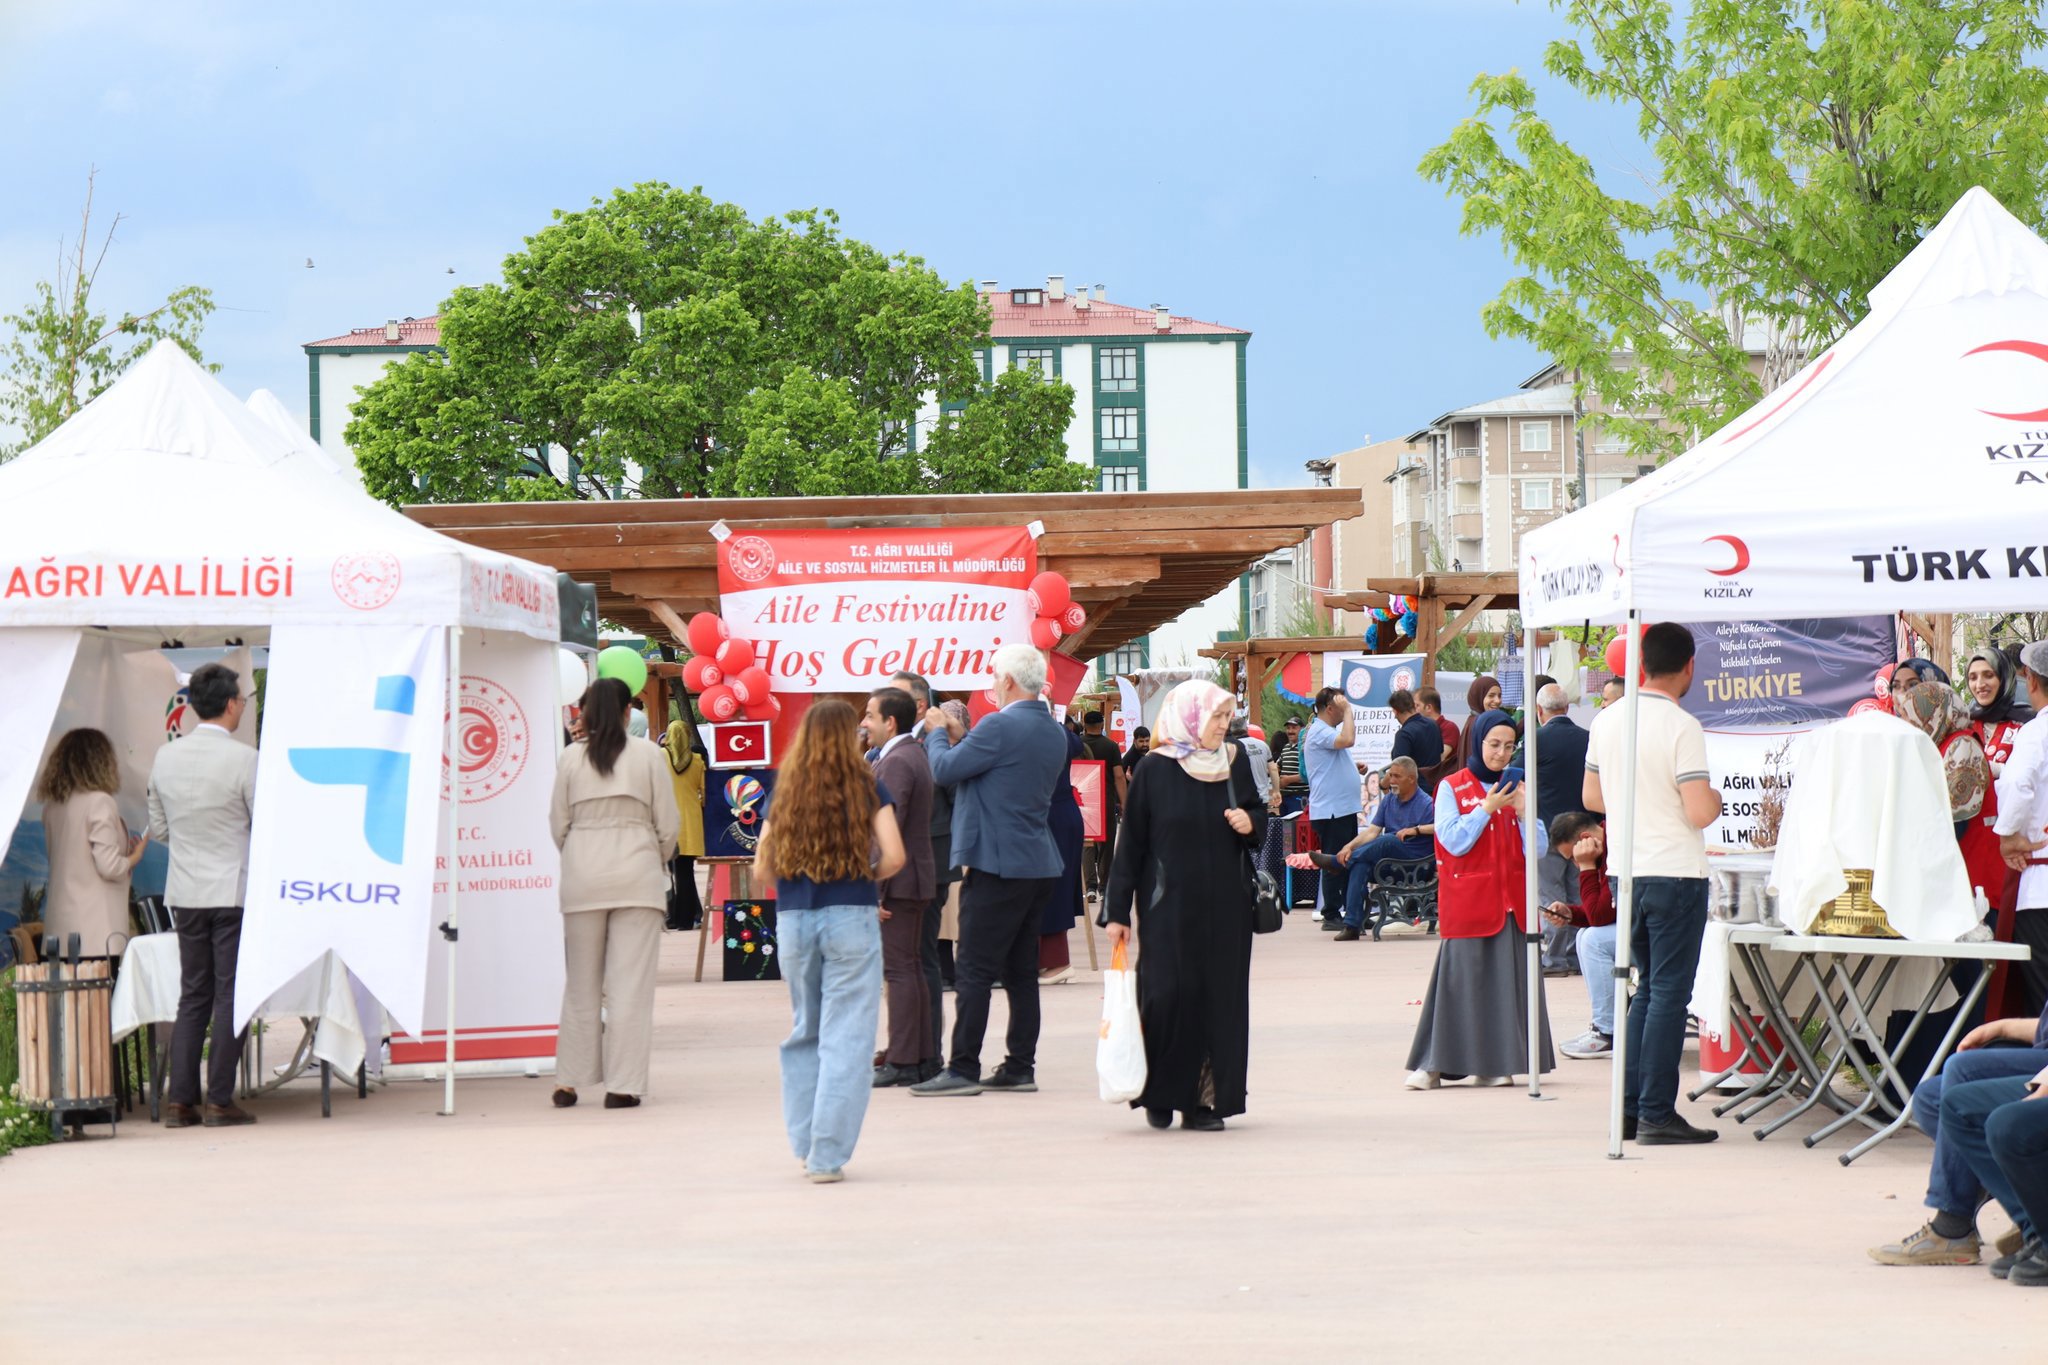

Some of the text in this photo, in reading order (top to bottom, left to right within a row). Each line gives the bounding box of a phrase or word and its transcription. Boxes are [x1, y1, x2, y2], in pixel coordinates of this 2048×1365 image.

[2020, 429, 2048, 441] TÜ
[1985, 443, 2048, 461] KIZ
[850, 541, 953, 557] T.C. AĞRI VALİLİĞİ
[777, 562, 803, 575] AİLE
[806, 562, 821, 574] VE
[824, 561, 868, 574] SOSYAL
[870, 560, 935, 574] HİZMETLER
[938, 559, 950, 573] İL
[953, 556, 1026, 573] MÜDÜRLÜĞÜ
[1852, 545, 1991, 583] TÜRK
[4, 556, 104, 598] AĞRI
[118, 556, 293, 598] VALİLİĞİ
[1704, 587, 1753, 598] KIZILAY
[754, 593, 1007, 624] Aile Festivaline
[1715, 622, 1777, 638] Aileyle Köklenen
[1719, 637, 1782, 655] Nüfusla Güçlenen
[749, 637, 1002, 687] Hoş Geldini
[1751, 653, 1782, 666] Yükselen
[1703, 668, 1803, 703] TÜRKİYE
[1370, 710, 1394, 720] DEST
[1355, 722, 1390, 735] ERKEZİ
[1723, 771, 1794, 790] AĞRI VALİ
[1722, 826, 1734, 844] İL
[458, 848, 533, 869] VALİLİĞİ
[468, 874, 553, 892] MÜDÜRLÜĞÜ
